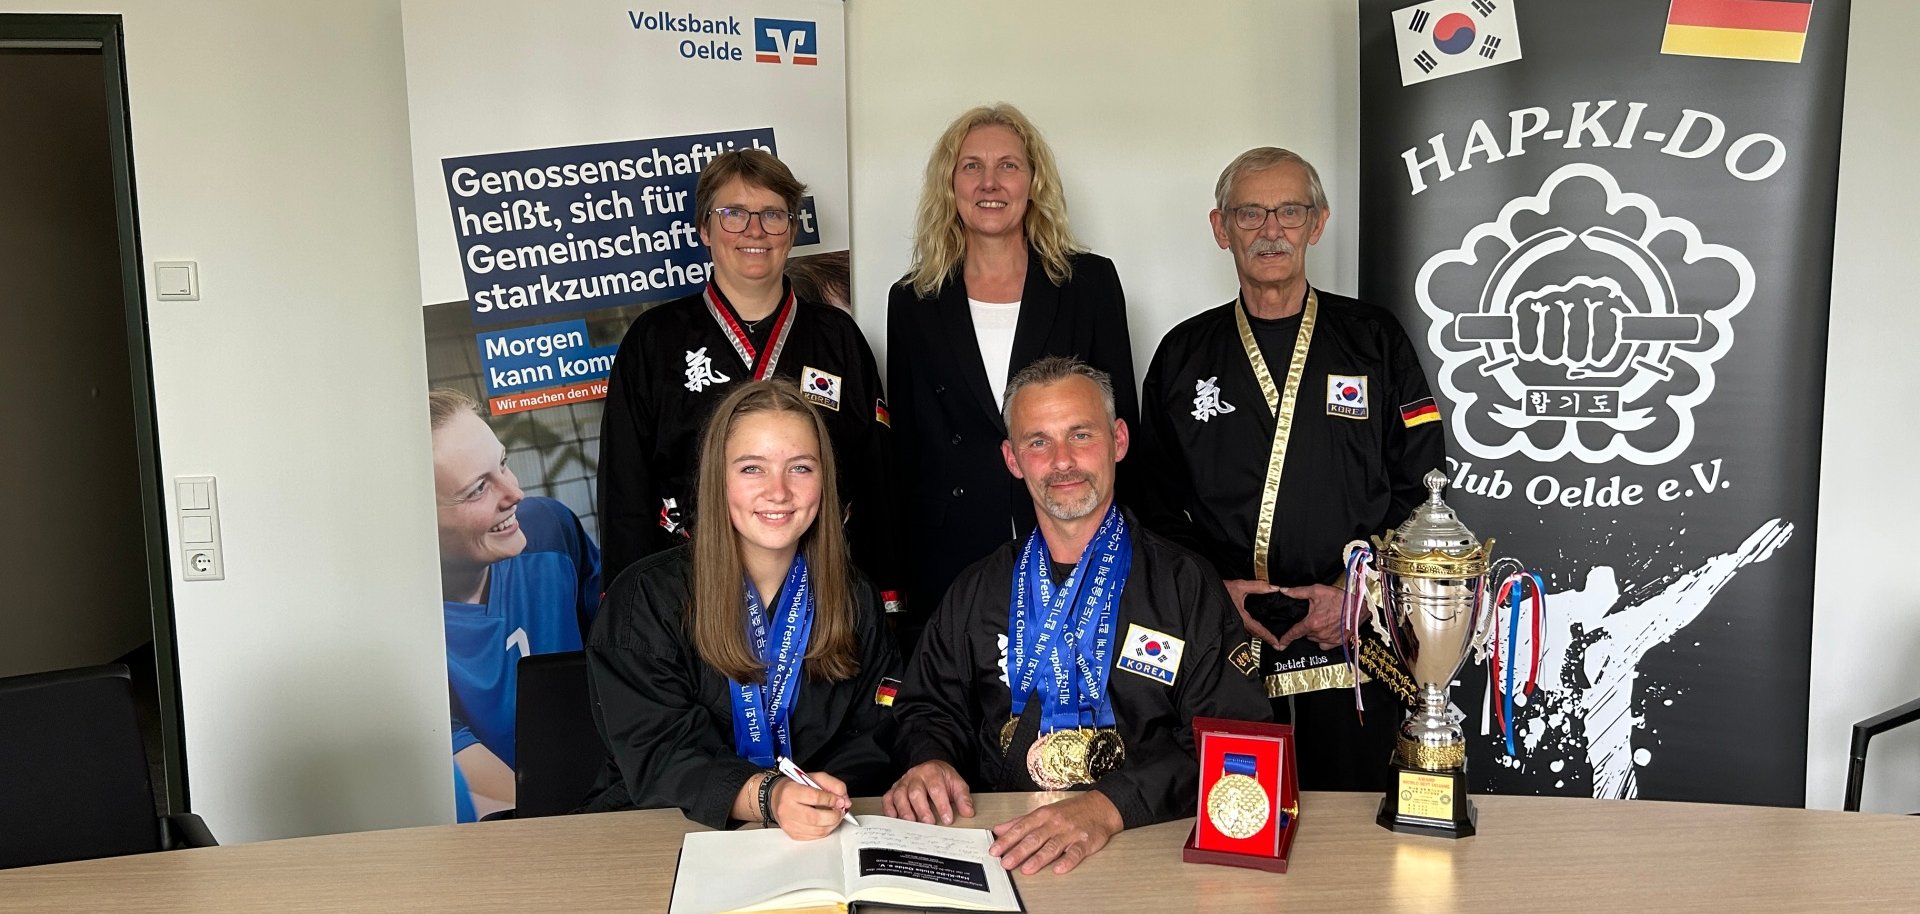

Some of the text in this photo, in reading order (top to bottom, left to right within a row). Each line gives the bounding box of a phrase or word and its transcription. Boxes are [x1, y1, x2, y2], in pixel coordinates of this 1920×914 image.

[628, 11, 741, 36] Volksbank
[679, 40, 742, 61] Oelde
[1400, 99, 1787, 196] HAP-KI-DO
[451, 138, 772, 198] Genossenschaft
[457, 186, 688, 237] heißt, sich für
[466, 221, 699, 275] Gemeinschaft
[485, 330, 584, 360] Morgen
[489, 364, 553, 389] kann
[497, 384, 608, 411] Wir machen den We
[1330, 404, 1367, 417] KOREA
[1530, 391, 1611, 415] 합기도
[1526, 475, 1643, 508] Oelde
[1658, 459, 1730, 501] e.V.
[1017, 571, 1026, 608] Festival
[787, 584, 805, 623] Hapkido
[1016, 610, 1025, 618] &
[778, 625, 796, 663] Festival
[776, 664, 786, 672] &
[1126, 659, 1166, 679] KOREA
[1274, 656, 1306, 672] Detlef
